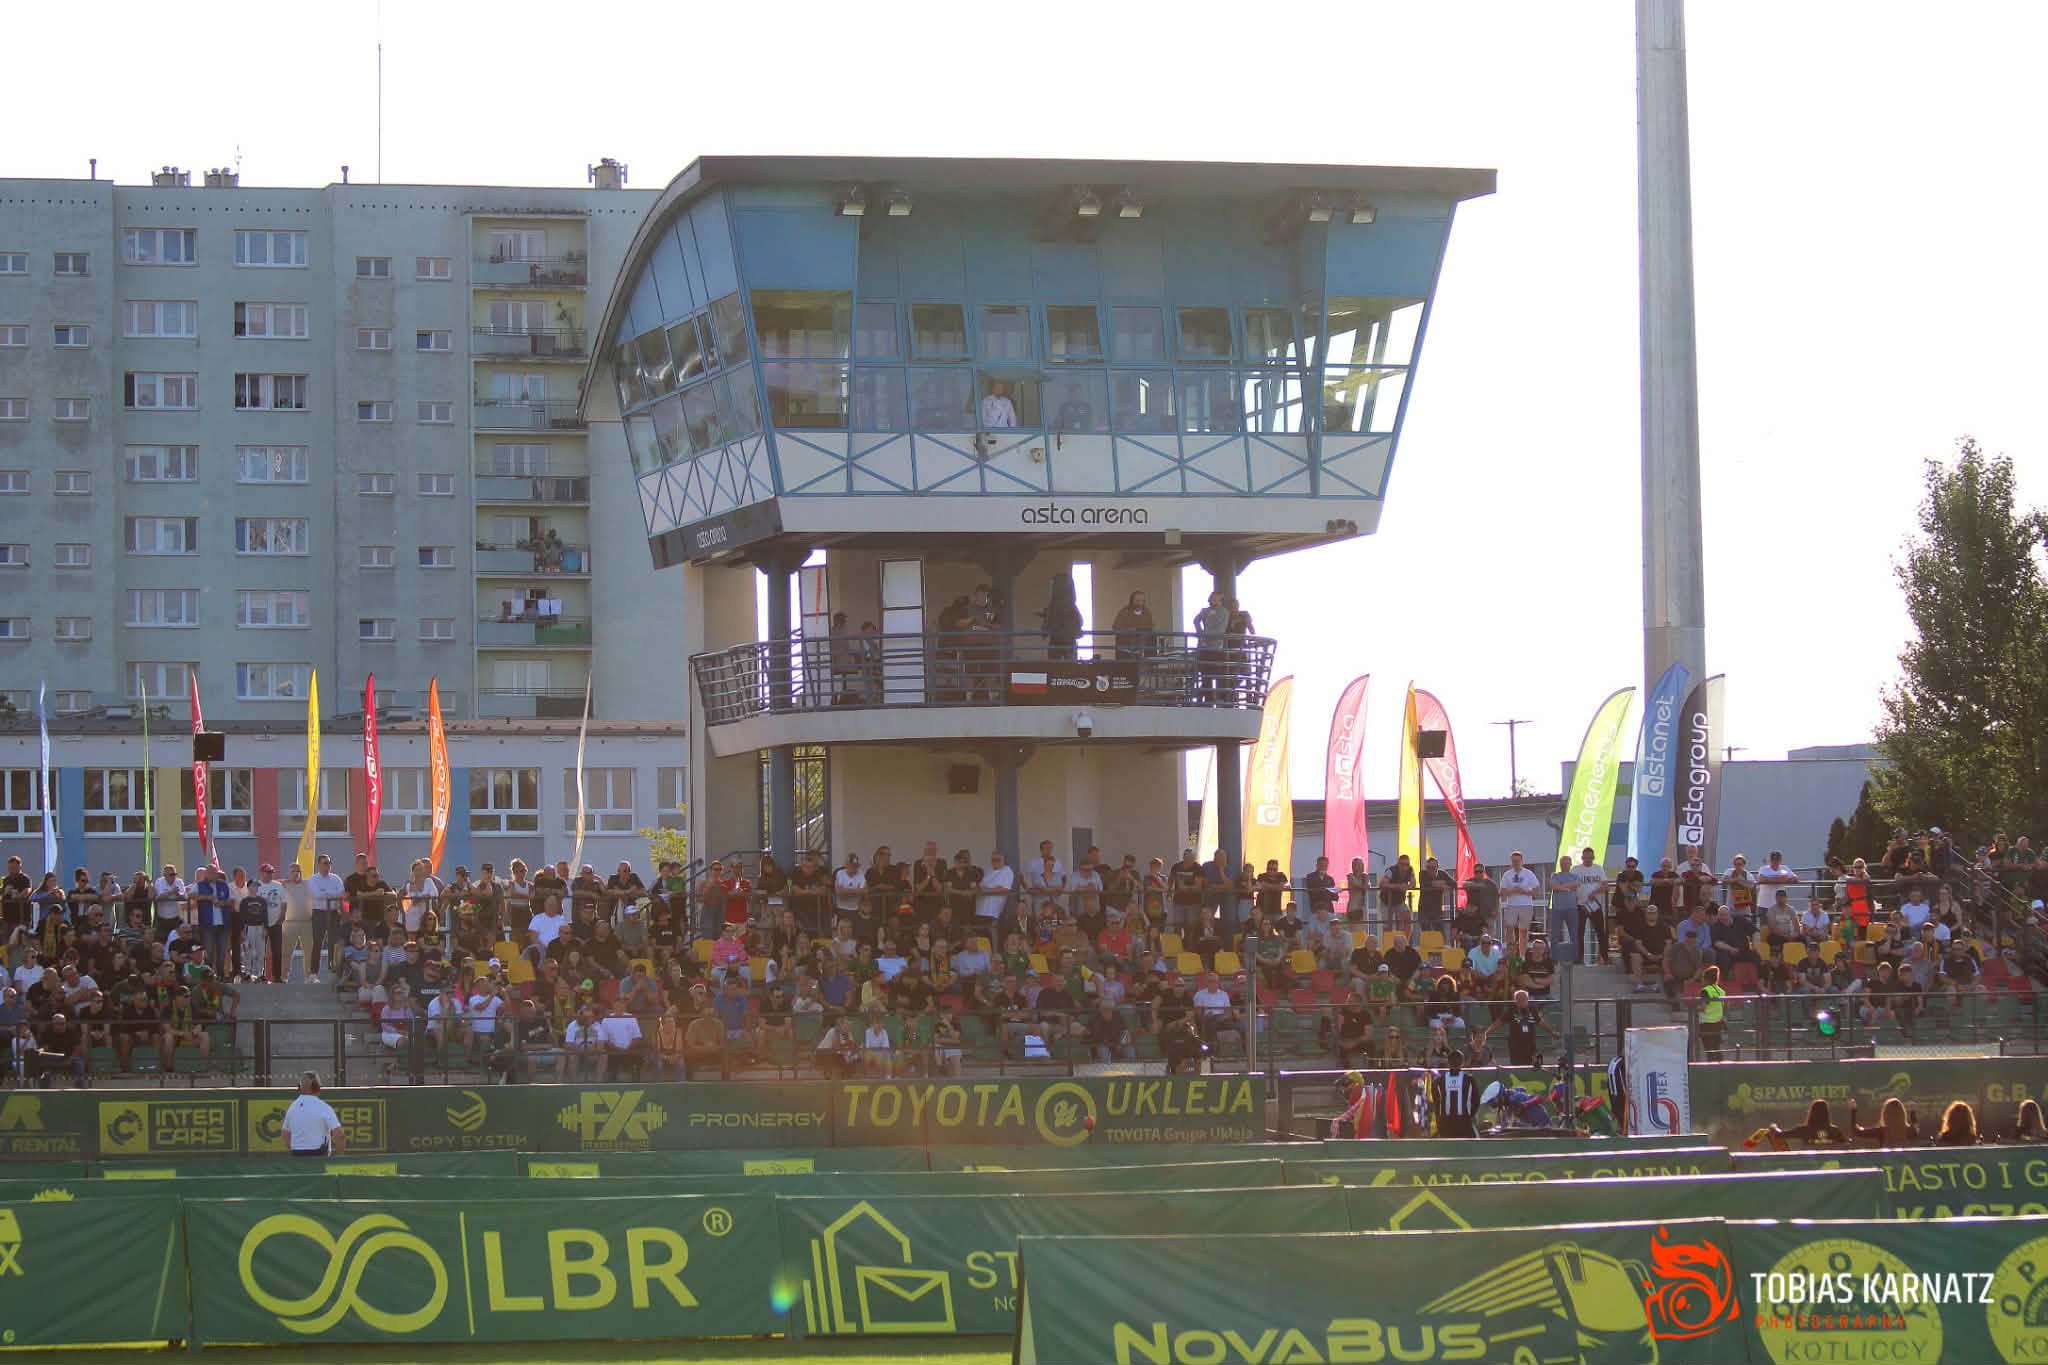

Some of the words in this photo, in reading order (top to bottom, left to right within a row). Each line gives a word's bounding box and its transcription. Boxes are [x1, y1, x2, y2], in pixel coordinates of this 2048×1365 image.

[1021, 502, 1075, 524] asta
[1080, 508, 1148, 524] arena
[1645, 695, 1675, 797] astanet
[1682, 711, 1713, 845] astagroup
[843, 1083, 1026, 1128] TOYOTA
[1105, 1079, 1254, 1117] UKLEJA
[1751, 1085, 1850, 1101] SPAW-MET
[155, 1109, 225, 1125] INTER
[687, 1111, 827, 1128] PRONERGY
[155, 1129, 225, 1145] CARS
[409, 1135, 456, 1149] COPY
[461, 1134, 529, 1147] SYSTEM
[1104, 1128, 1161, 1142] TOYOTA
[1884, 1162, 1987, 1193] IASTO
[482, 1226, 699, 1313] LBR
[1784, 1339, 1929, 1362] KOTLICCY
